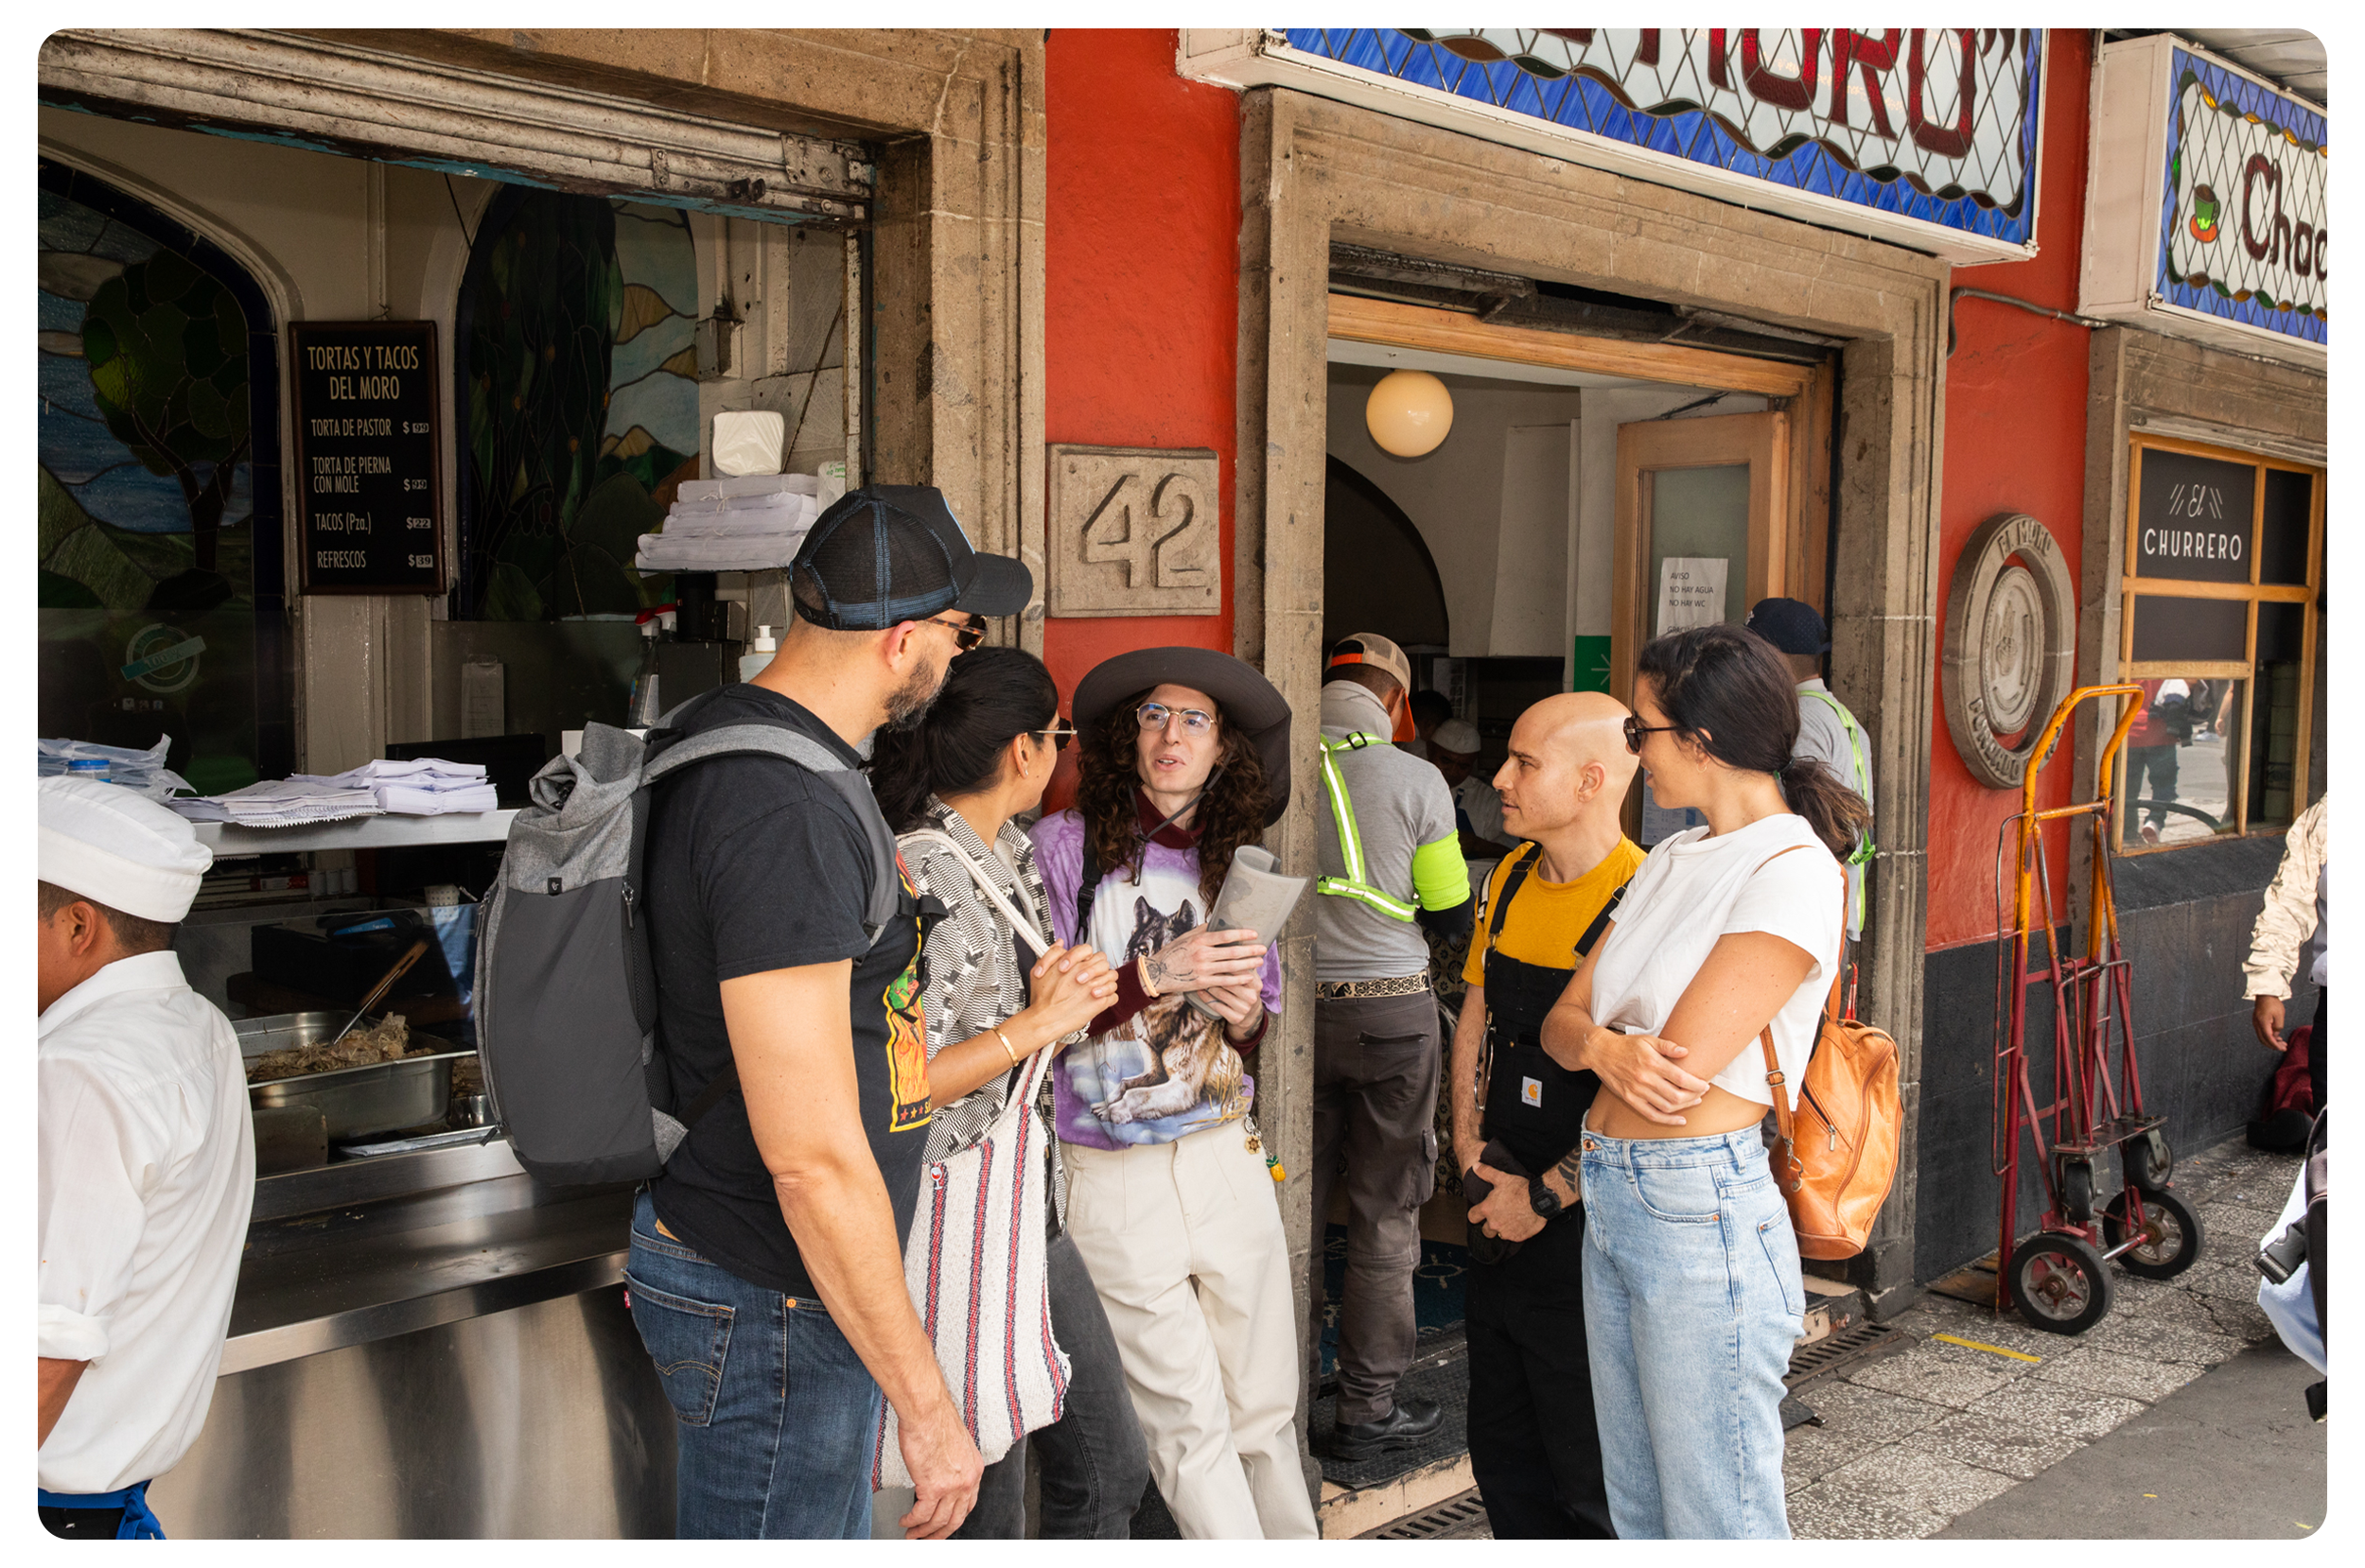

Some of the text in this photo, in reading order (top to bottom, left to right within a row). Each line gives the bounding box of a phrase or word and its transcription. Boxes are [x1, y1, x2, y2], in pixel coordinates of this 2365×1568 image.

[307, 346, 419, 370] TORTAS Y TACOS
[330, 375, 400, 400] DEL MORO
[311, 419, 341, 437] TORTA
[342, 419, 355, 436] DE
[357, 418, 392, 436] PASTOR
[312, 456, 392, 474] TORTA DE PIERNA
[314, 476, 332, 493] CON
[335, 475, 359, 493] MOLE
[2188, 483, 2206, 517] El
[315, 513, 343, 531] TACOS
[346, 512, 372, 534] (Pza.)
[1078, 473, 1207, 589] 42
[2144, 528, 2242, 561] CHURRERO
[317, 550, 367, 568] REFRESCOS
[1669, 585, 1680, 594] NO
[1669, 599, 1679, 607] NO
